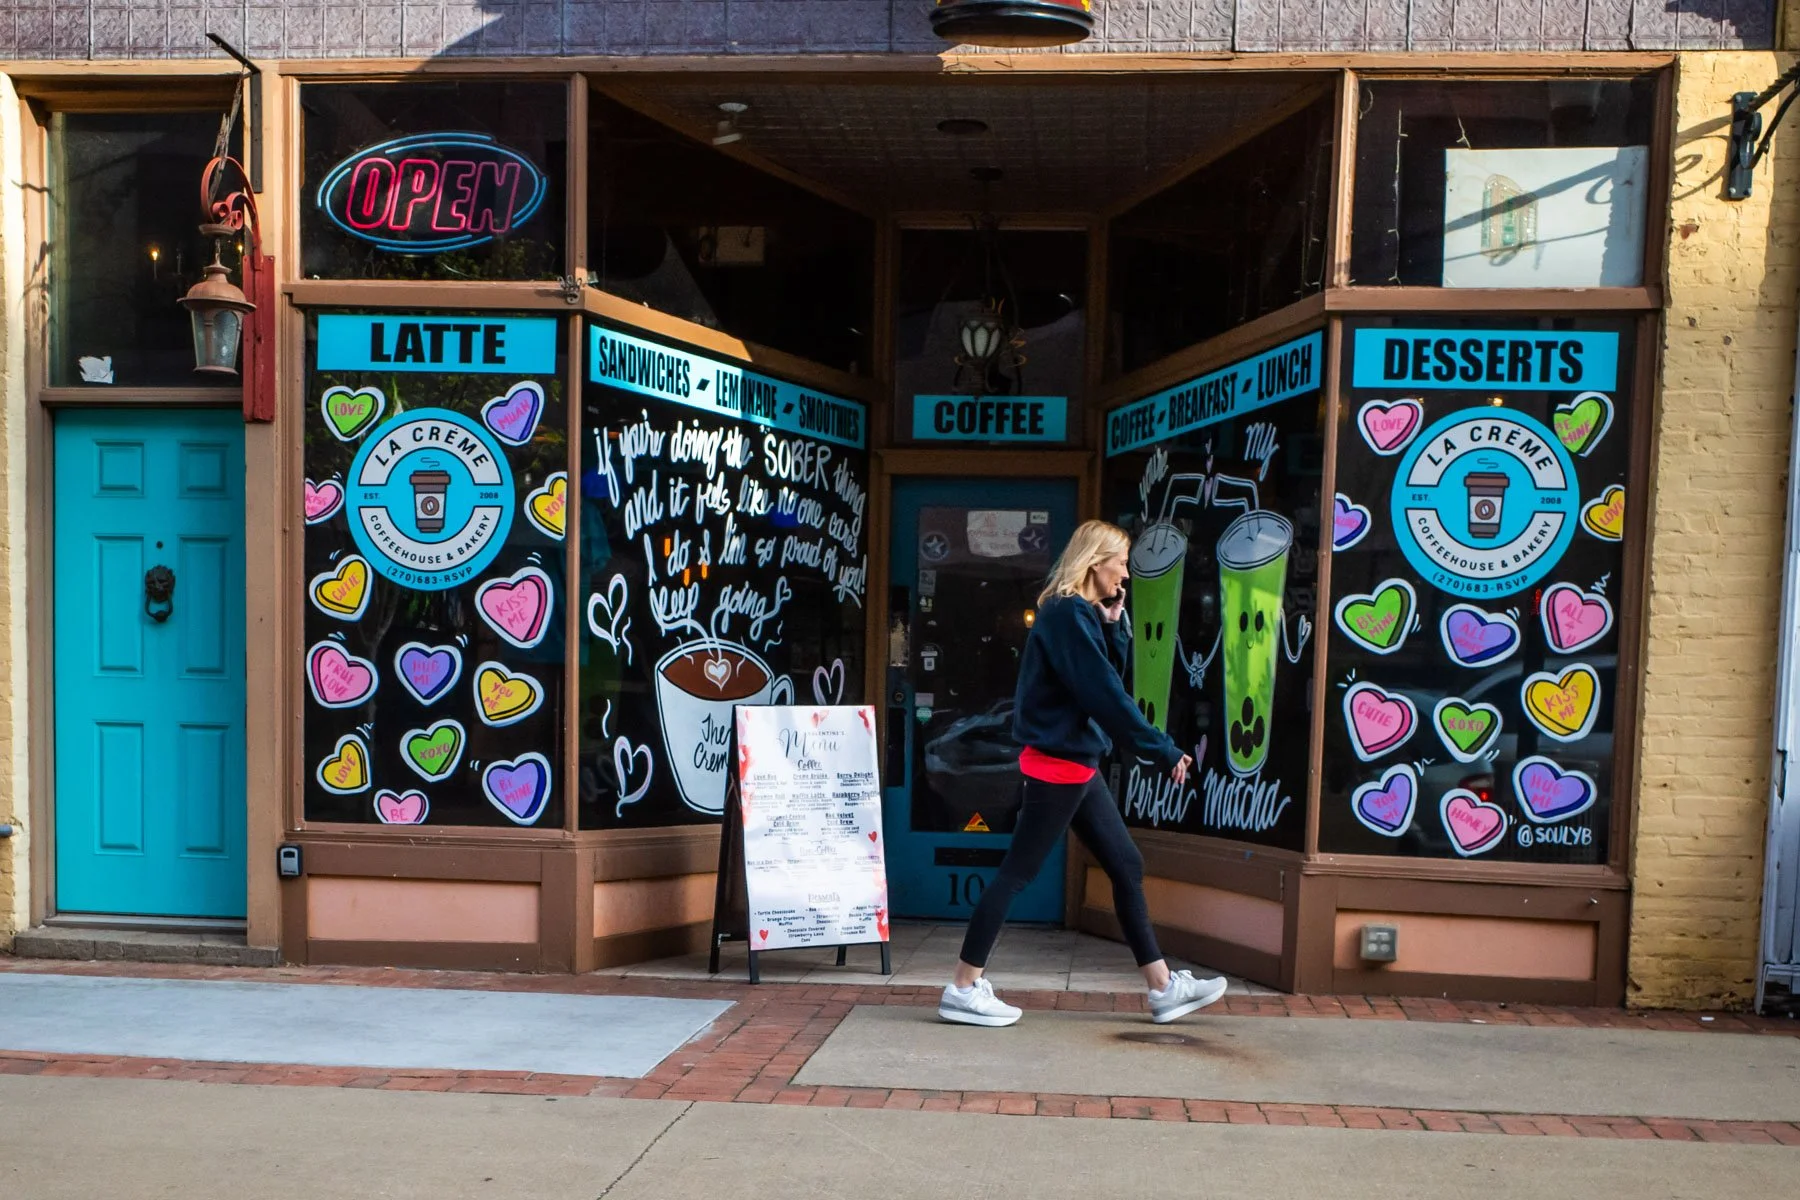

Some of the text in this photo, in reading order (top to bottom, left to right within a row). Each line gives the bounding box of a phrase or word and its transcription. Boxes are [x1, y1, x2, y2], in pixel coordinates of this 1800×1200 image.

[346, 157, 522, 233] OPEN
[370, 322, 506, 365] LATTE
[1383, 337, 1584, 384] DESSERTS
[599, 334, 691, 399] SANDWICHES
[715, 368, 777, 421] LEMONADE
[798, 393, 860, 444] SMOOTHIES
[1110, 401, 1156, 449] COFFEE
[1167, 371, 1238, 432] BREAKFAST
[1256, 342, 1313, 402] LUNCH
[334, 402, 365, 417] LOVE
[934, 400, 1044, 435] COFFEE
[1373, 416, 1405, 433] LOVE
[1561, 419, 1592, 446] MINE
[375, 438, 402, 467] LA
[1426, 437, 1457, 467] LA
[670, 419, 723, 481] doing
[721, 425, 754, 470] the
[833, 456, 867, 538] thing
[479, 491, 499, 500] 2008
[1540, 496, 1562, 505] 2008
[624, 469, 859, 559] and it feels like no one cares
[370, 513, 491, 565] COFFEEHOUSE & BAKERY
[1417, 516, 1552, 571] COFFEEHOUSE & BAKERY
[666, 528, 692, 577] do
[754, 535, 776, 568] so
[780, 534, 823, 568] proud
[822, 543, 839, 582] of
[331, 572, 361, 602] CUTIE
[386, 565, 474, 586] (270)683-RSVP
[1432, 571, 1529, 593] (270)683-RSVP
[495, 591, 529, 617] KISS
[716, 580, 772, 642] going
[1560, 602, 1583, 625] ALL
[507, 608, 529, 629] ME
[1355, 612, 1377, 631] BE
[1367, 610, 1396, 639] MINE
[1566, 634, 1577, 645] U
[326, 658, 355, 686] TRUE
[322, 674, 348, 698] LOVE
[491, 681, 514, 698] YOU
[1543, 684, 1580, 714] KISS
[1356, 701, 1394, 728] CUTIE
[1447, 716, 1485, 733] XOXO
[1558, 702, 1577, 722] ME
[700, 712, 732, 746] The
[419, 742, 451, 760] XOXO
[776, 727, 840, 759] Menu
[334, 752, 358, 785] LOVE
[797, 759, 823, 771] Coffee
[504, 781, 534, 805] MINE
[1530, 772, 1563, 797] HUG
[1203, 767, 1291, 832] Matcha
[1371, 788, 1398, 809] YOU
[390, 807, 408, 822] BE
[1450, 806, 1491, 834] HONEY
[1517, 824, 1592, 848] @SOULYB
